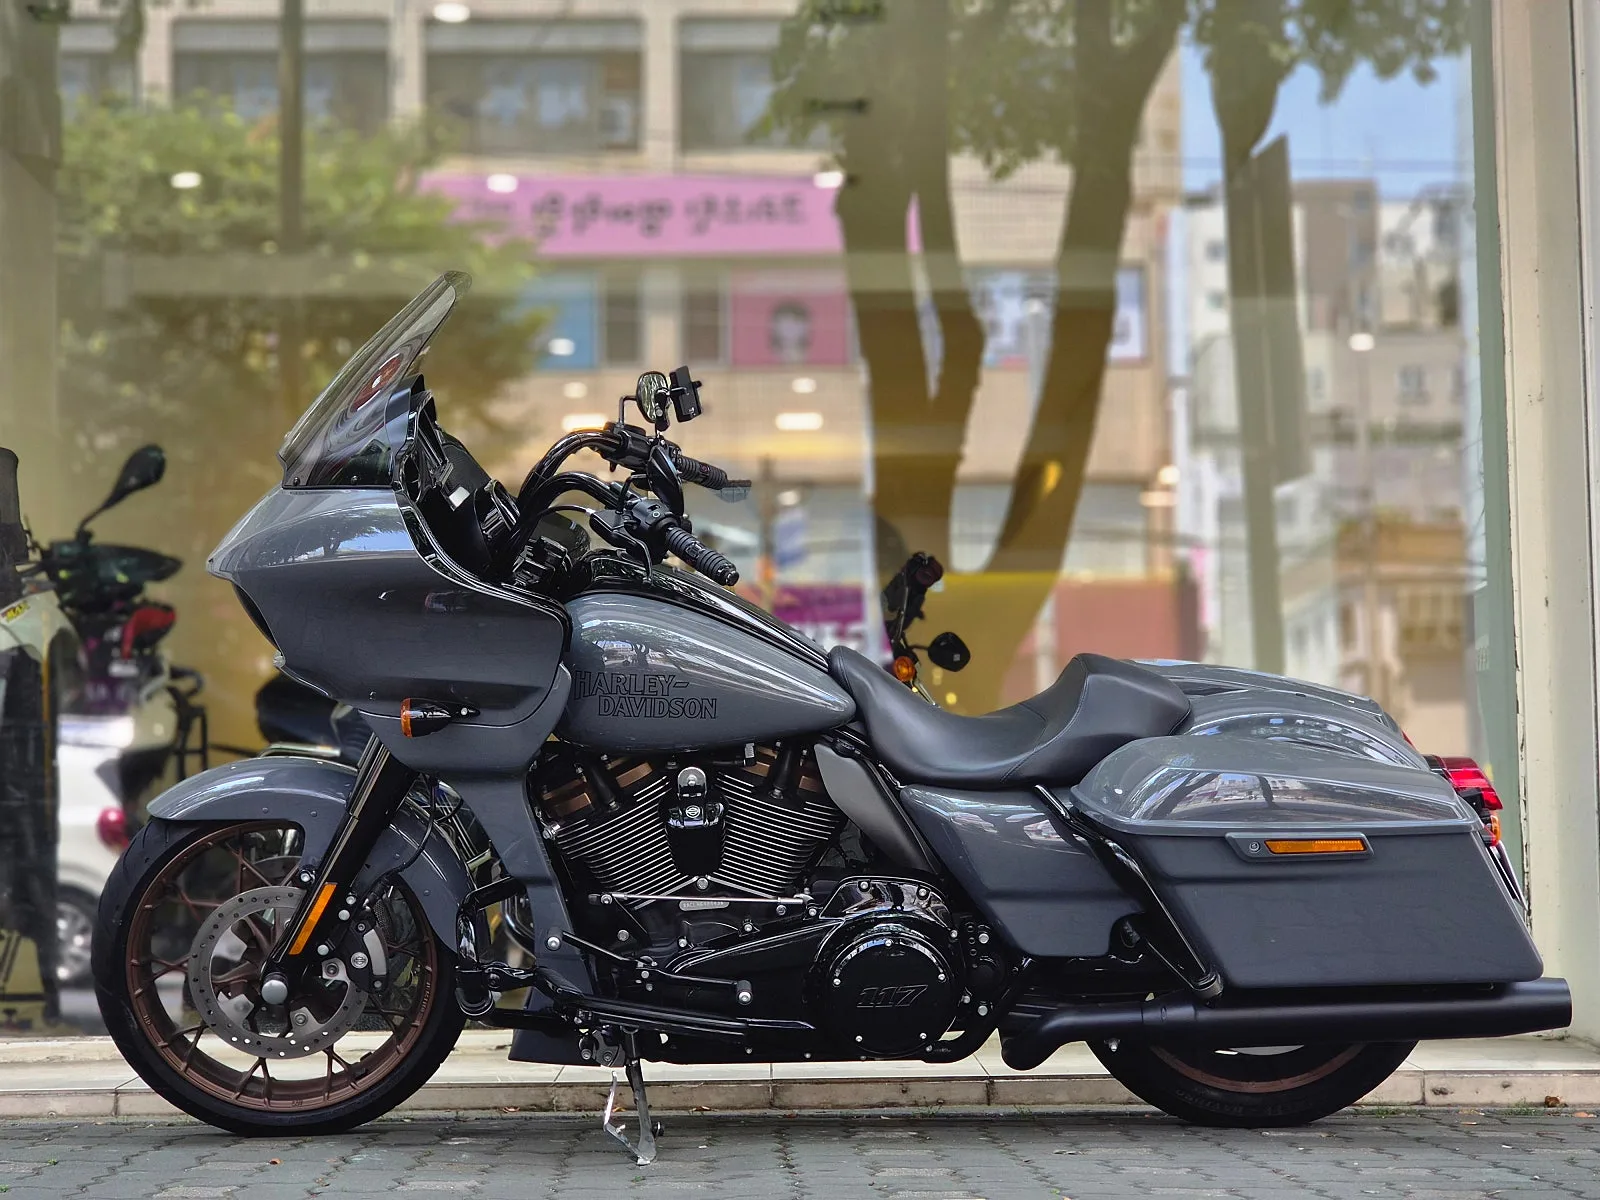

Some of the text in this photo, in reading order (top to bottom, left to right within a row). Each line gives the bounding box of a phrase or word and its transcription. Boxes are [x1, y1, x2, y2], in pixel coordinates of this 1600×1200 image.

[574, 670, 689, 699] HARLEY-
[599, 695, 718, 719] DAVIDSON
[856, 984, 928, 1008] 117
